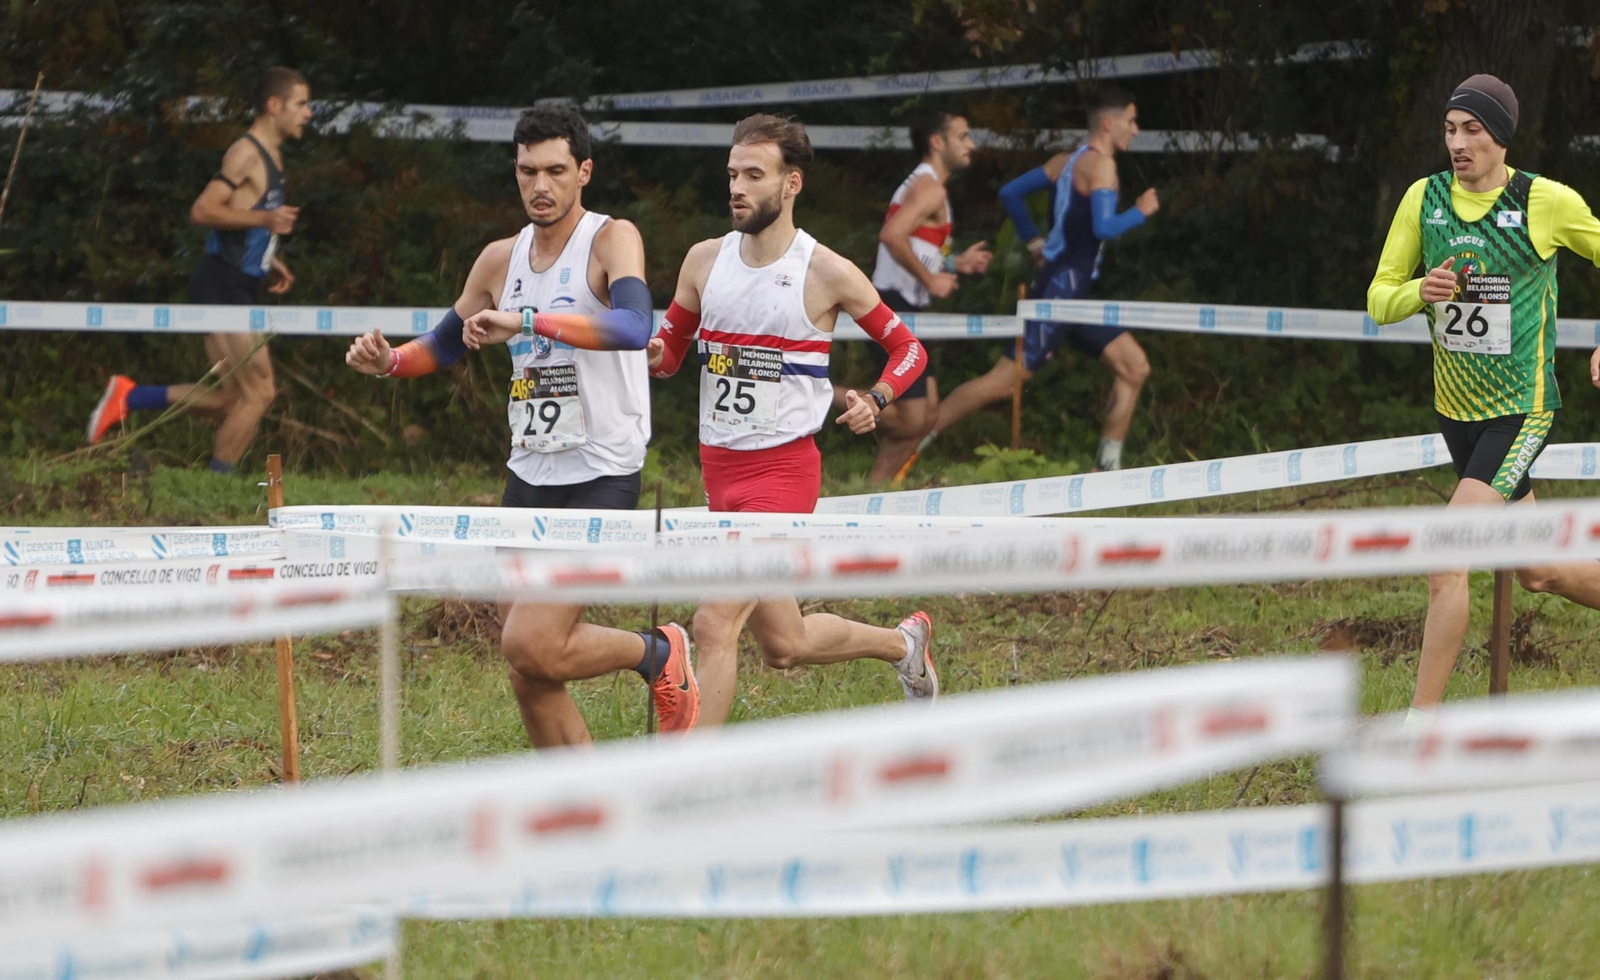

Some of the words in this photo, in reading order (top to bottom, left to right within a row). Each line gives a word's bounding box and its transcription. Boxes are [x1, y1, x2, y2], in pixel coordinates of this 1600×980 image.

[1449, 235, 1485, 248] LUCUS
[1466, 284, 1510, 292] BELARMINO
[1478, 292, 1509, 300] ALONSO
[1444, 304, 1489, 337] 26
[742, 350, 782, 362] MEMORIAL
[738, 358, 782, 370] BELARMINO
[541, 367, 576, 377] MEMORIAL
[748, 368, 780, 378] ALONSO
[540, 376, 577, 386] BELARMINO
[550, 384, 577, 393] ALONSO
[715, 377, 756, 415] 25
[523, 400, 561, 436] 29
[1506, 434, 1539, 489] LUCUS
[420, 516, 454, 526] DEPORTE
[473, 517, 501, 527] XUNTA
[553, 519, 587, 529] DEPORTE
[604, 520, 632, 530] XUNTA
[418, 528, 450, 538] GALEGO
[470, 529, 481, 538] DE
[483, 529, 517, 539] GALICIA
[551, 532, 582, 541] GALEGO
[602, 532, 612, 542] DE
[615, 532, 648, 542] GALICIA
[173, 532, 211, 545] DEPORTE
[27, 542, 65, 552] DEPORTE
[84, 540, 116, 551] XUNTA
[280, 563, 334, 578] CONCELLO
[336, 562, 350, 576] DE
[354, 561, 378, 575] VIGO
[101, 568, 156, 586] CONCELLO
[159, 568, 174, 583] DE
[177, 568, 201, 582] VIGO
